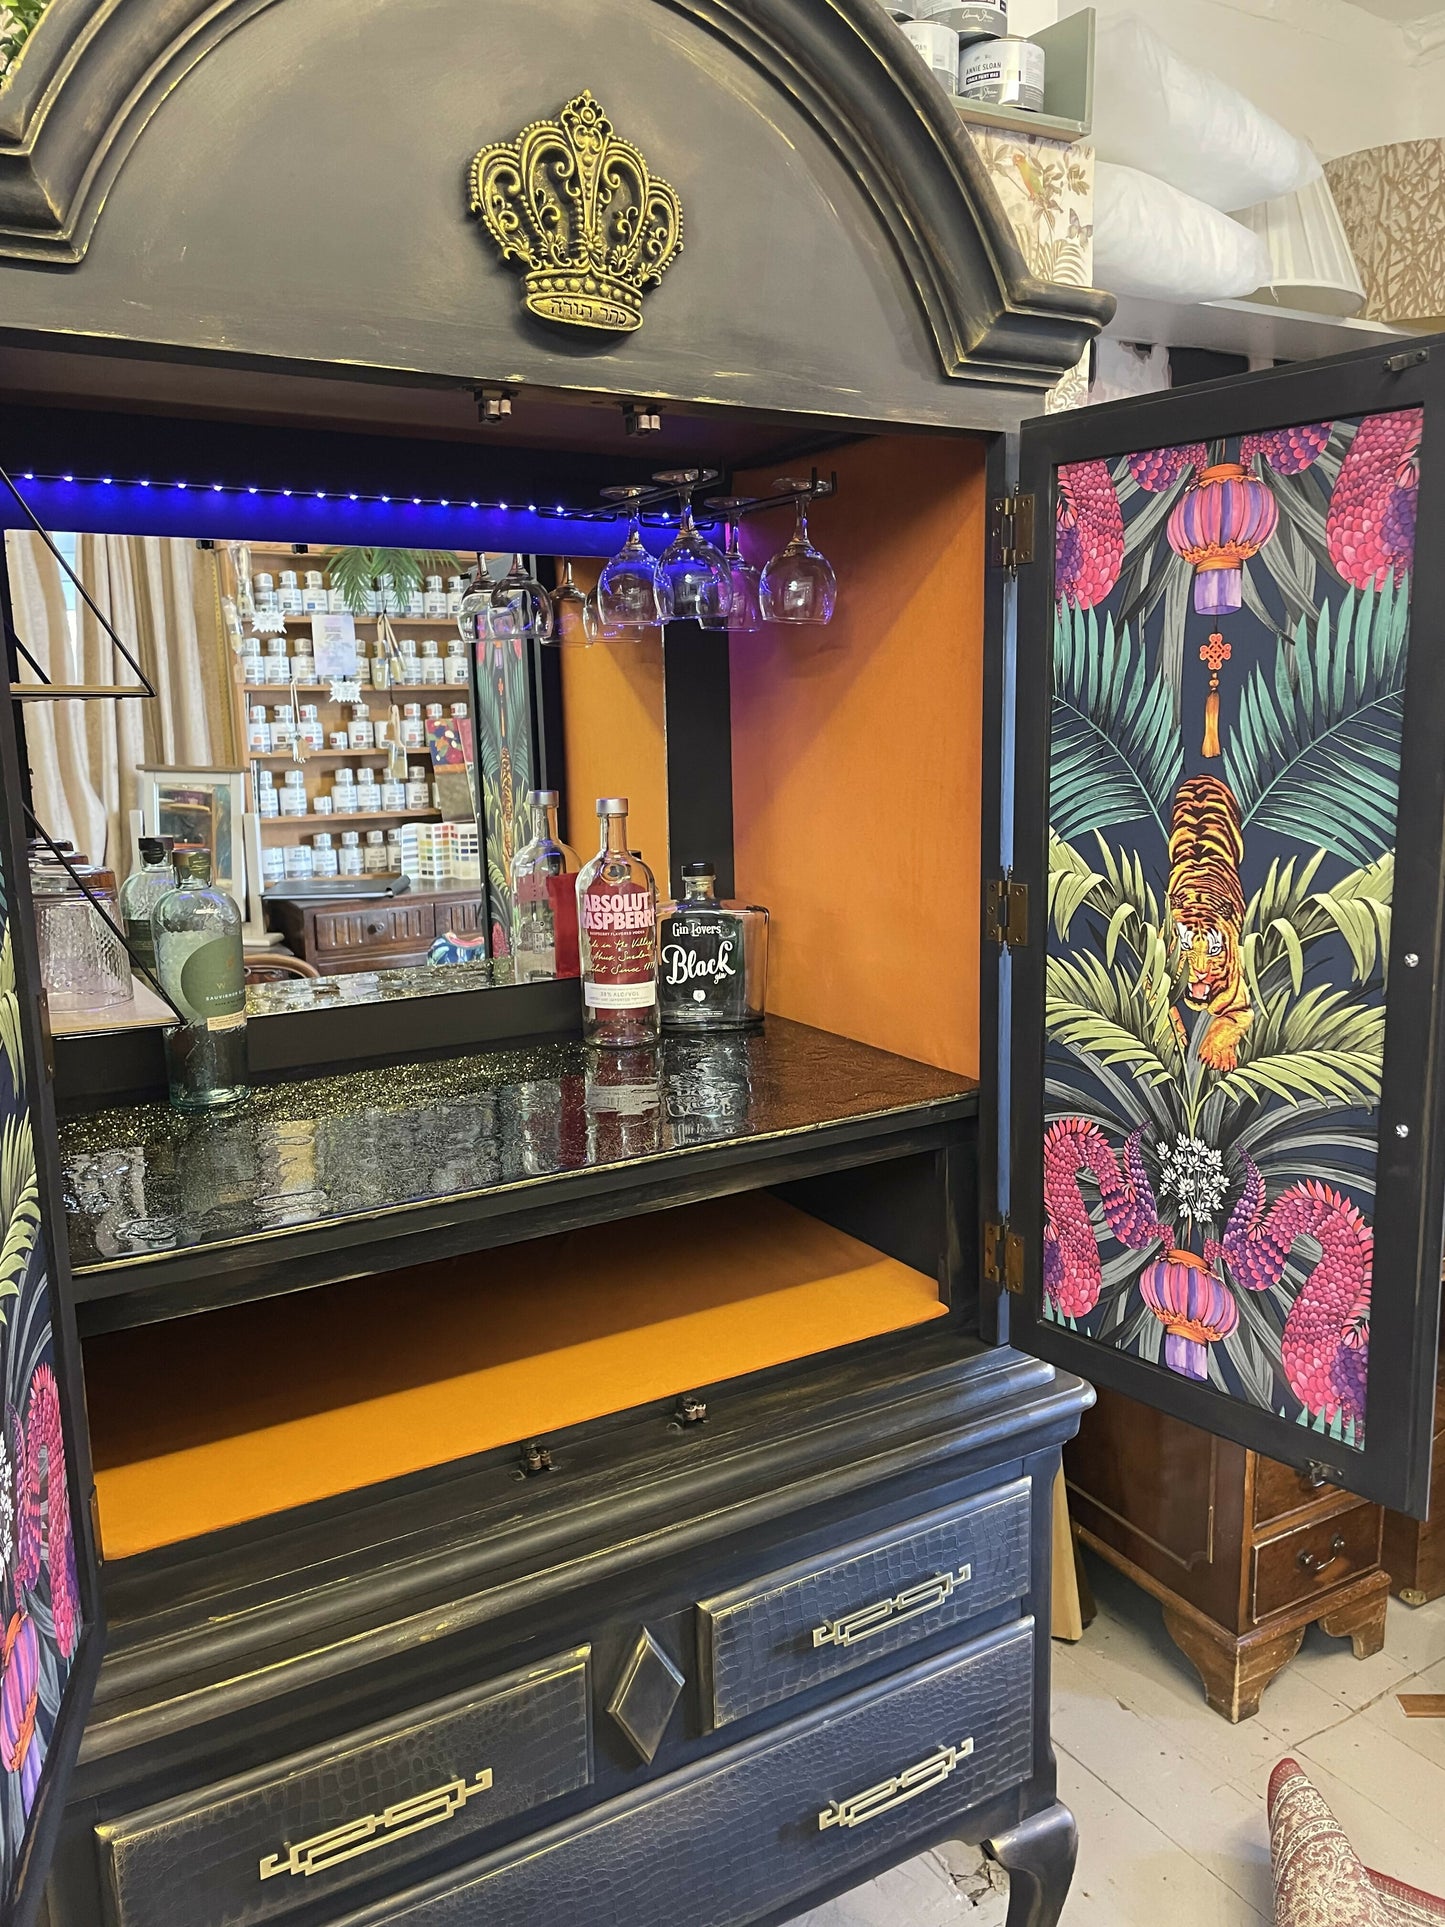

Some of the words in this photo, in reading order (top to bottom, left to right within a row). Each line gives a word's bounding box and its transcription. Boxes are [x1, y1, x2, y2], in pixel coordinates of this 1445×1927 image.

[966, 64, 981, 75] ANNIE
[982, 62, 1002, 71] SLOAN
[583, 892, 651, 913] ABSOLUT
[672, 922, 689, 937] Gin
[690, 922, 722, 937] Lovers
[614, 940, 629, 949] the
[611, 963, 641, 975] Since
[661, 940, 737, 985] Black
